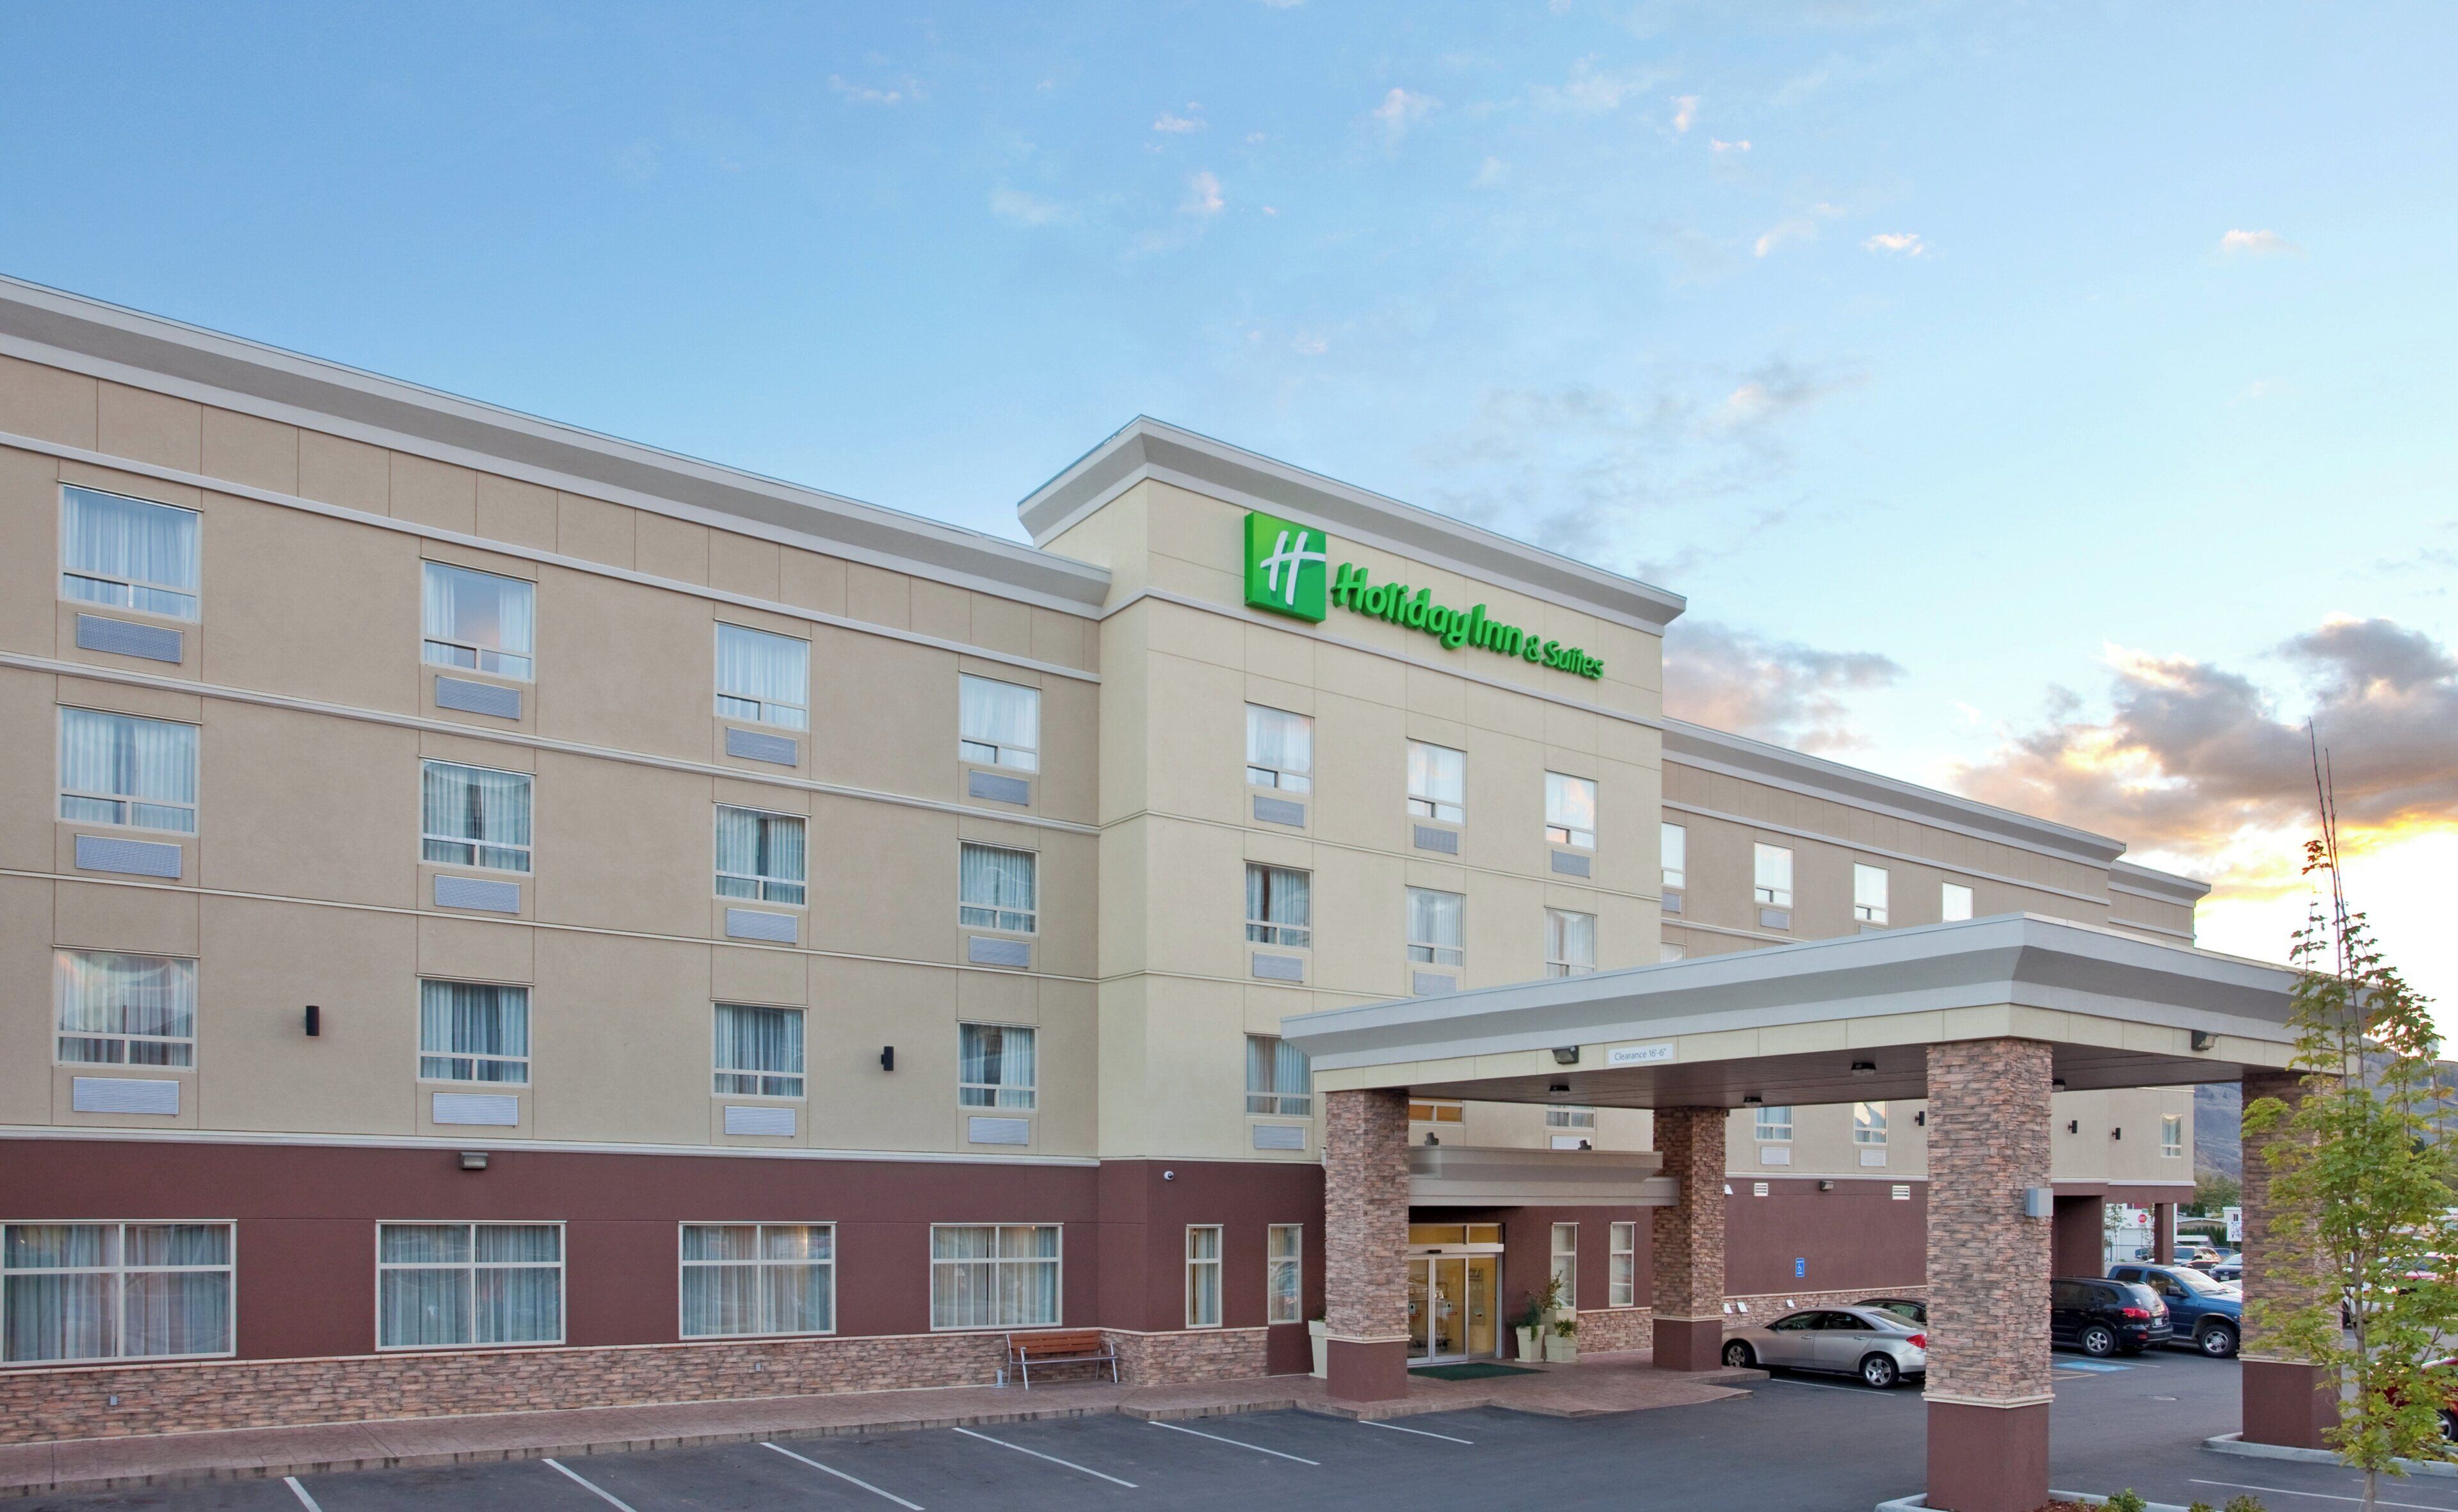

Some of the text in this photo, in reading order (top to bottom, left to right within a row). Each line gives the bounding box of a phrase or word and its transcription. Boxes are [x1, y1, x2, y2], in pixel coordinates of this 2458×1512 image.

[1523, 635, 1542, 663] &
[1541, 641, 1604, 680] Suites
[1614, 1052, 1647, 1061] Clearance
